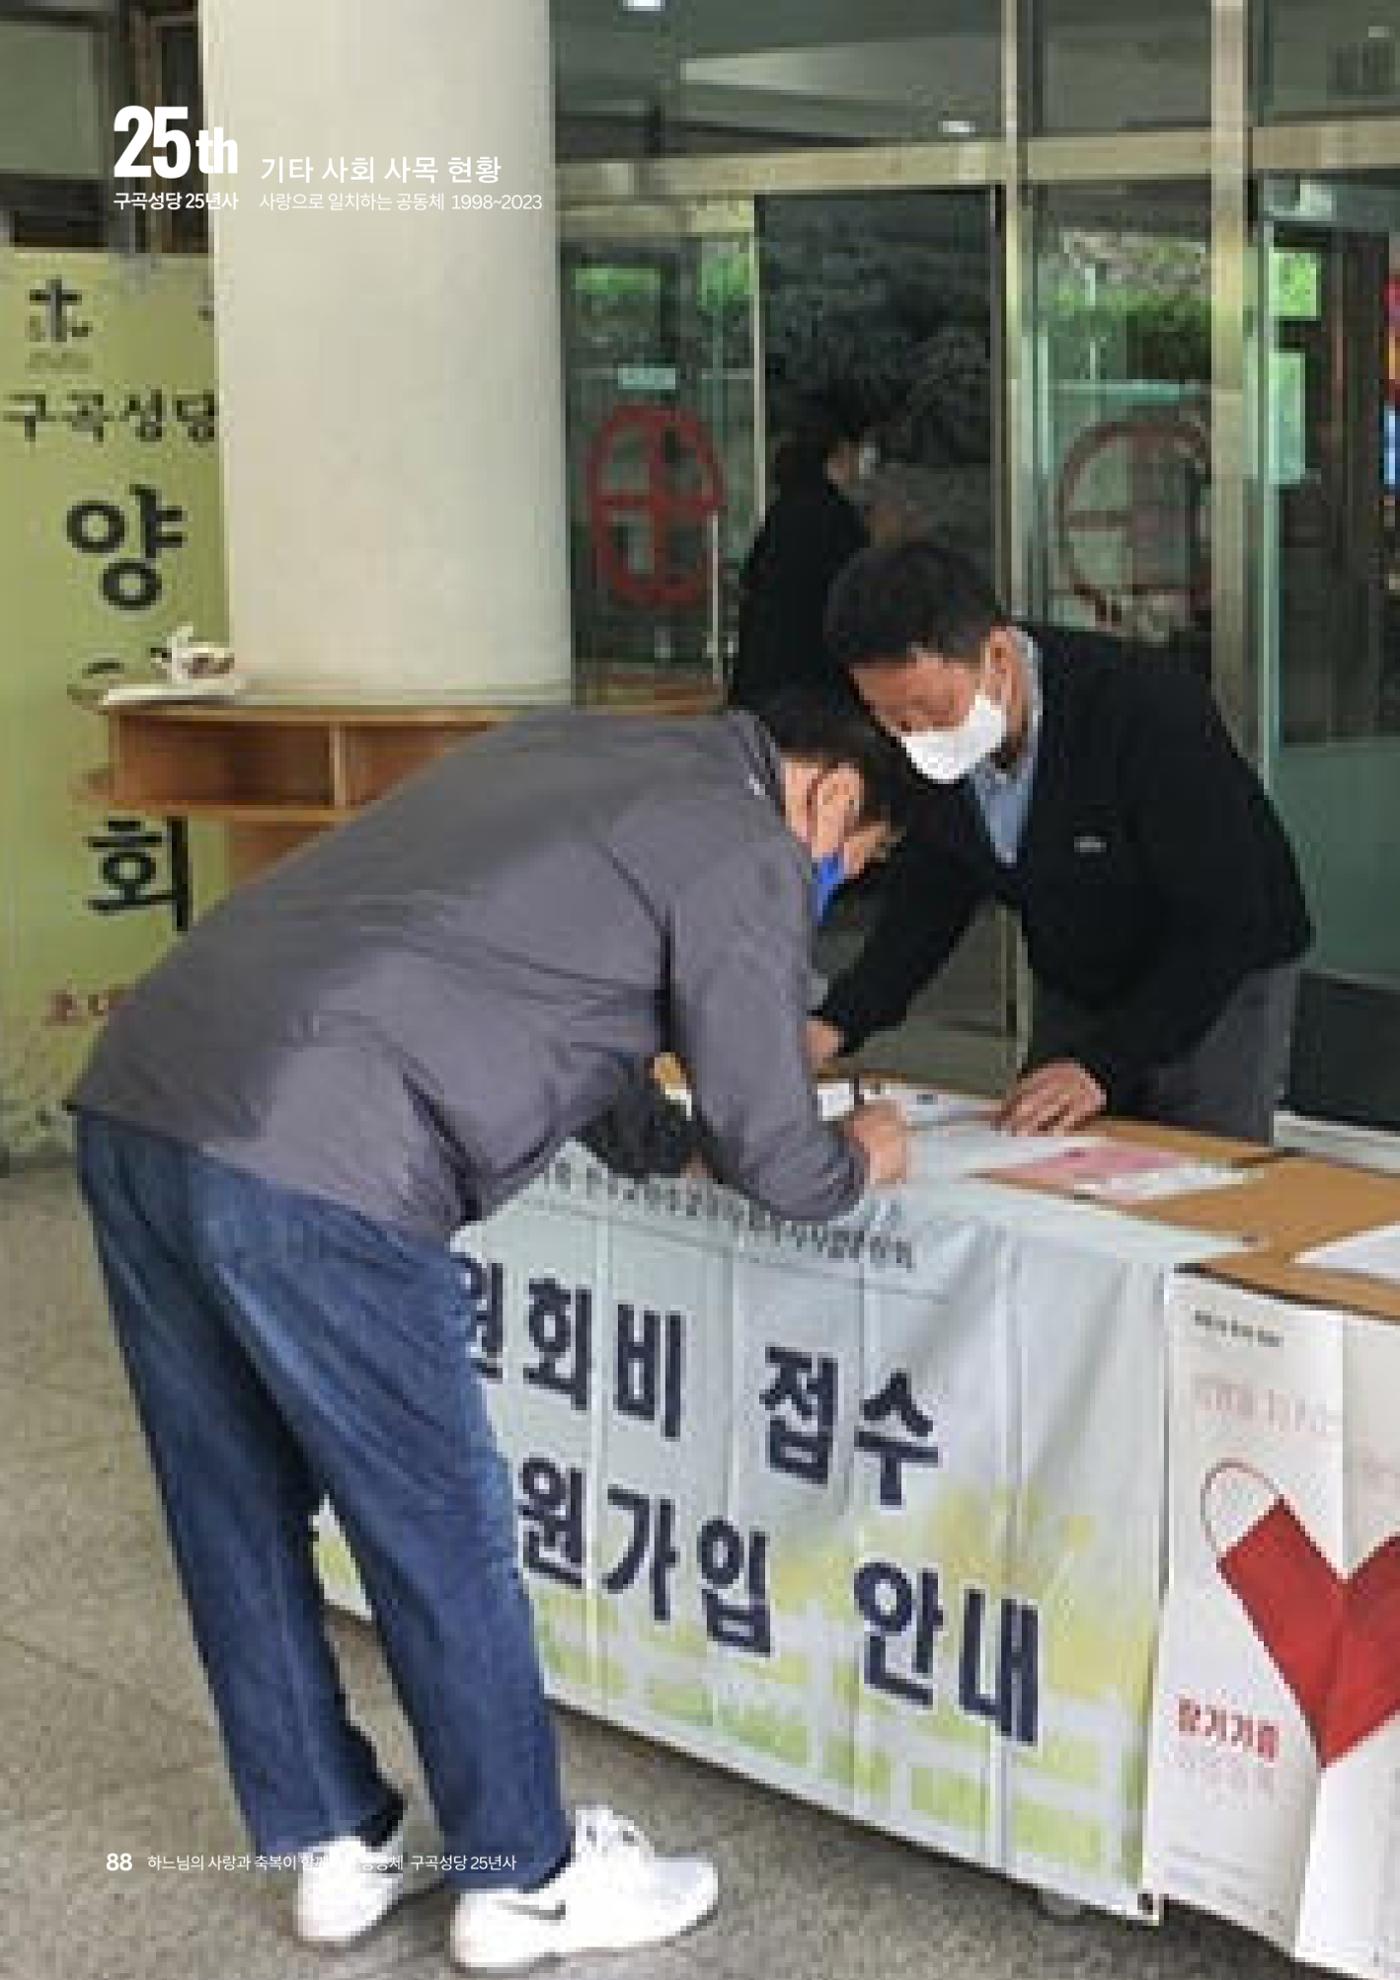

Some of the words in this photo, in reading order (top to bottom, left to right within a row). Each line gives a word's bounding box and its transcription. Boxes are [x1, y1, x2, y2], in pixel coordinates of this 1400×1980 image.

[3, 388, 215, 447] 구곡성당
[759, 1345, 939, 1506] 접수
[853, 1560, 1039, 1746] 안내
